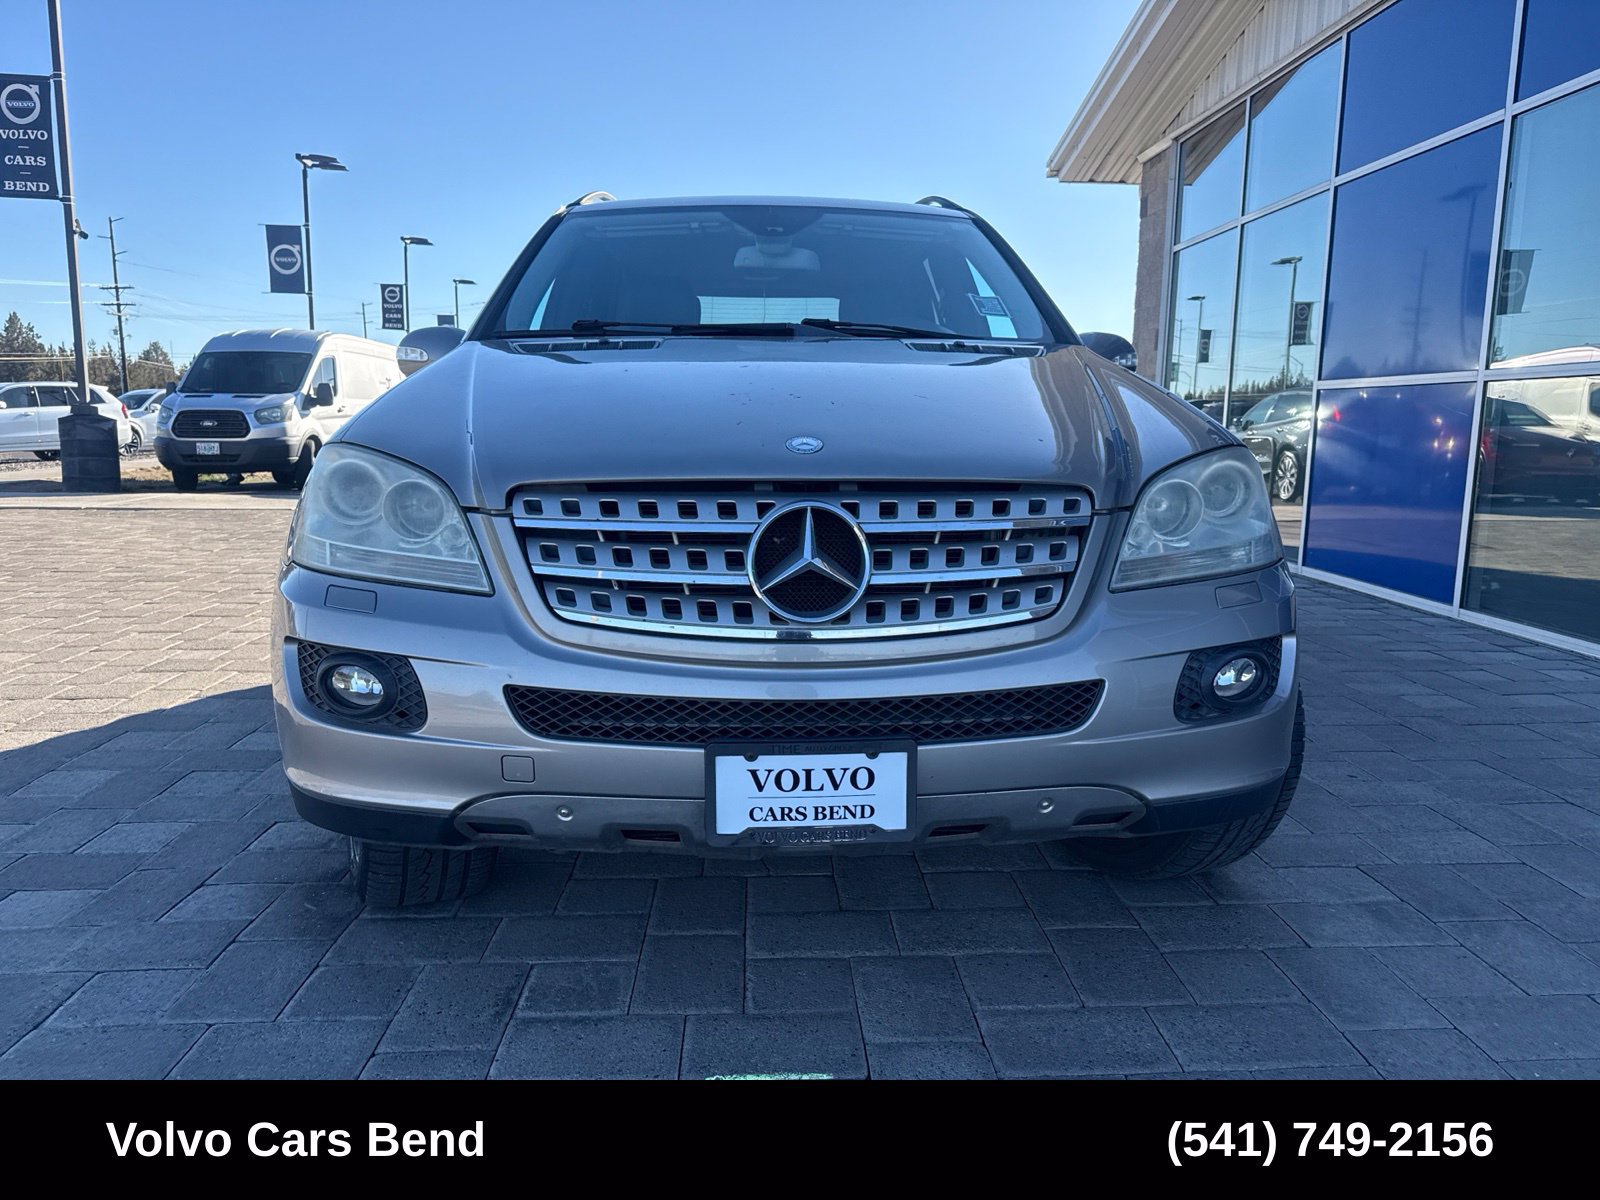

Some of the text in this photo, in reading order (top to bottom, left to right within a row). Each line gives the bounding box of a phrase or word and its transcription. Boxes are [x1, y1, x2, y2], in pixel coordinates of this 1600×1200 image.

[0, 129, 48, 140] VOLVO
[4, 155, 46, 166] CARS
[4, 181, 49, 192] BEND
[747, 766, 876, 792] VOLVO
[749, 804, 875, 822] CARS BEND
[759, 829, 867, 844] VOLVO CARS BEND
